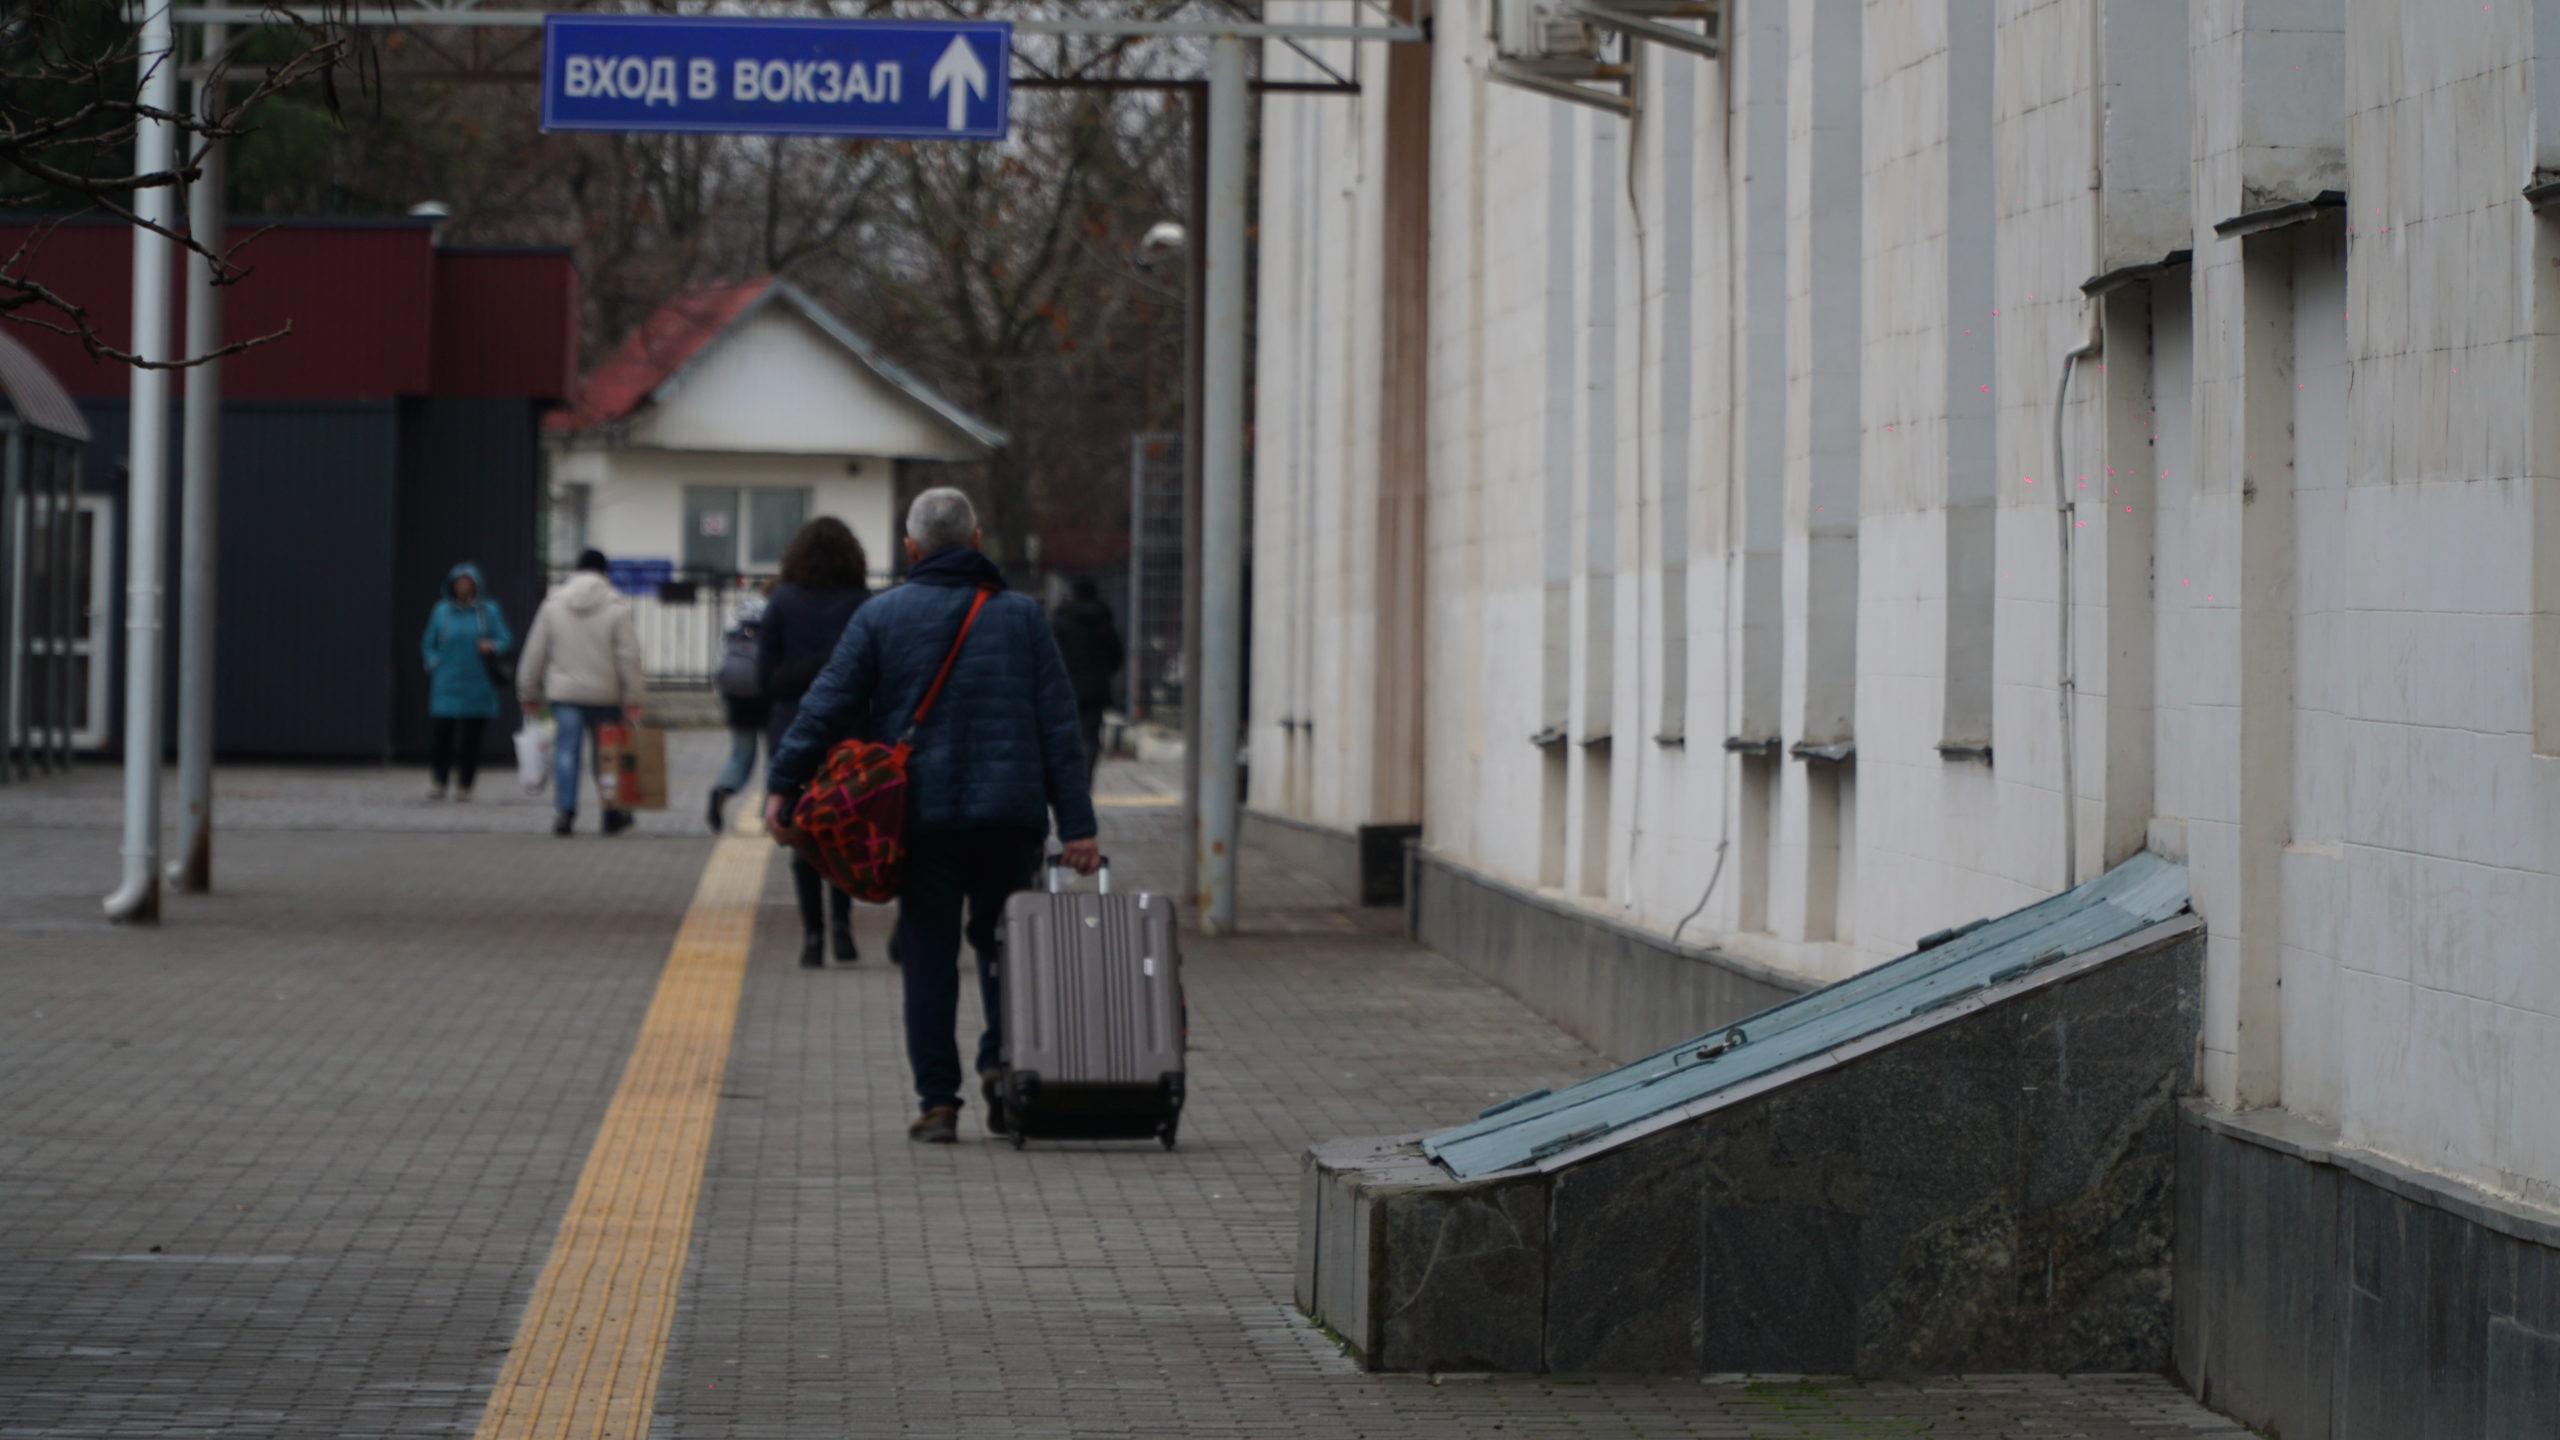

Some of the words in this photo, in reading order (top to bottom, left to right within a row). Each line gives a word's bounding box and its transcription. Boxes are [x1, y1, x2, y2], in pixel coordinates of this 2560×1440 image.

[565, 56, 678, 106] ВХОД
[688, 58, 716, 100] В
[733, 60, 901, 103] ВОКЗАЛ
